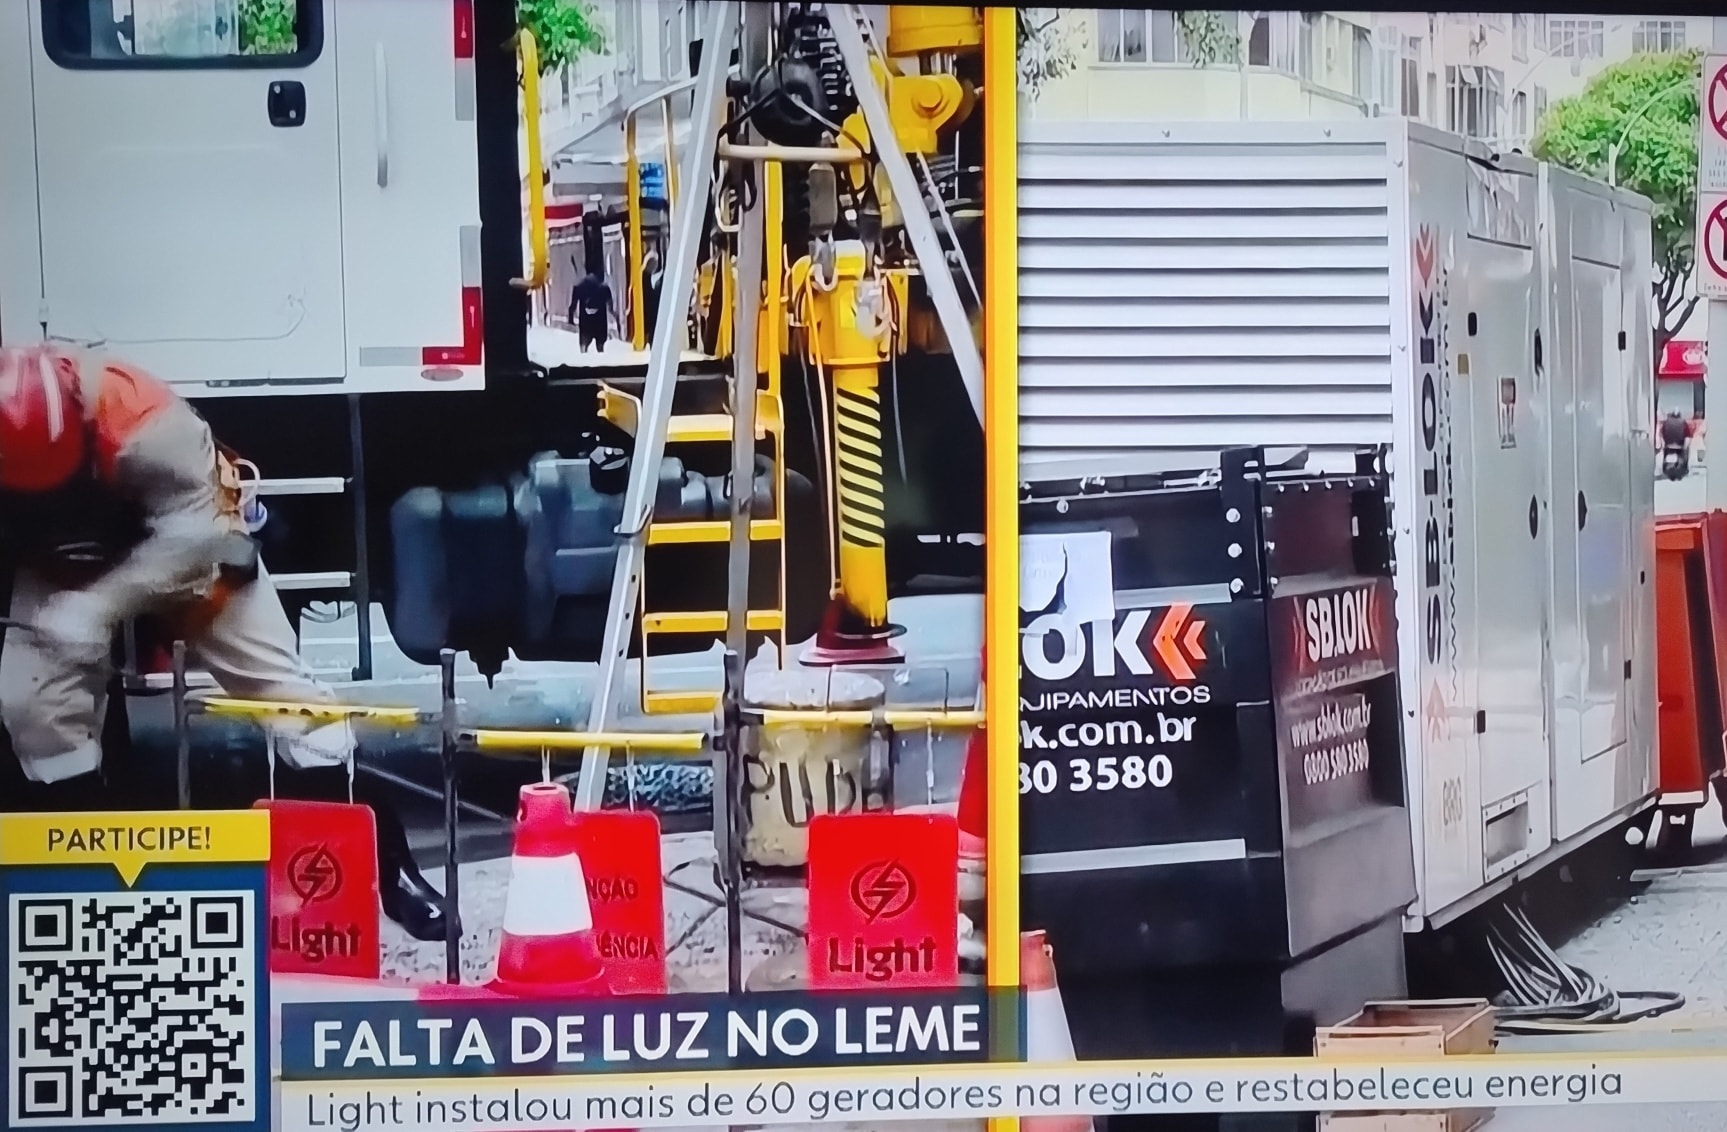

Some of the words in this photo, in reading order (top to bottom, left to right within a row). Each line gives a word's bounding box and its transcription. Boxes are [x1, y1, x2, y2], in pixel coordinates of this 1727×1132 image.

[1019, 611, 1154, 681] OK
[1019, 712, 1197, 750] k.com.br
[1069, 754, 1173, 792] 3580
[47, 825, 212, 852] PARTICIPE!
[587, 876, 639, 903] NÇÃO
[271, 919, 363, 962] Light
[828, 935, 938, 983] Light
[313, 1017, 496, 1068] FALTA
[511, 1014, 585, 1064] DE
[603, 1011, 709, 1062] LUZ
[727, 1008, 819, 1058] NO
[835, 1004, 981, 1055] LEME
[308, 1091, 404, 1132] Light
[416, 1087, 571, 1124] instalou
[586, 1085, 674, 1119] mais
[687, 1082, 734, 1117] de
[745, 1080, 796, 1115] 60
[808, 1076, 1003, 1120] geradores
[1016, 1084, 1061, 1107] na
[1074, 1071, 1193, 1112] região
[1205, 1080, 1225, 1103] e
[1236, 1066, 1473, 1102] restabeleceu
[1485, 1063, 1622, 1103] energia
